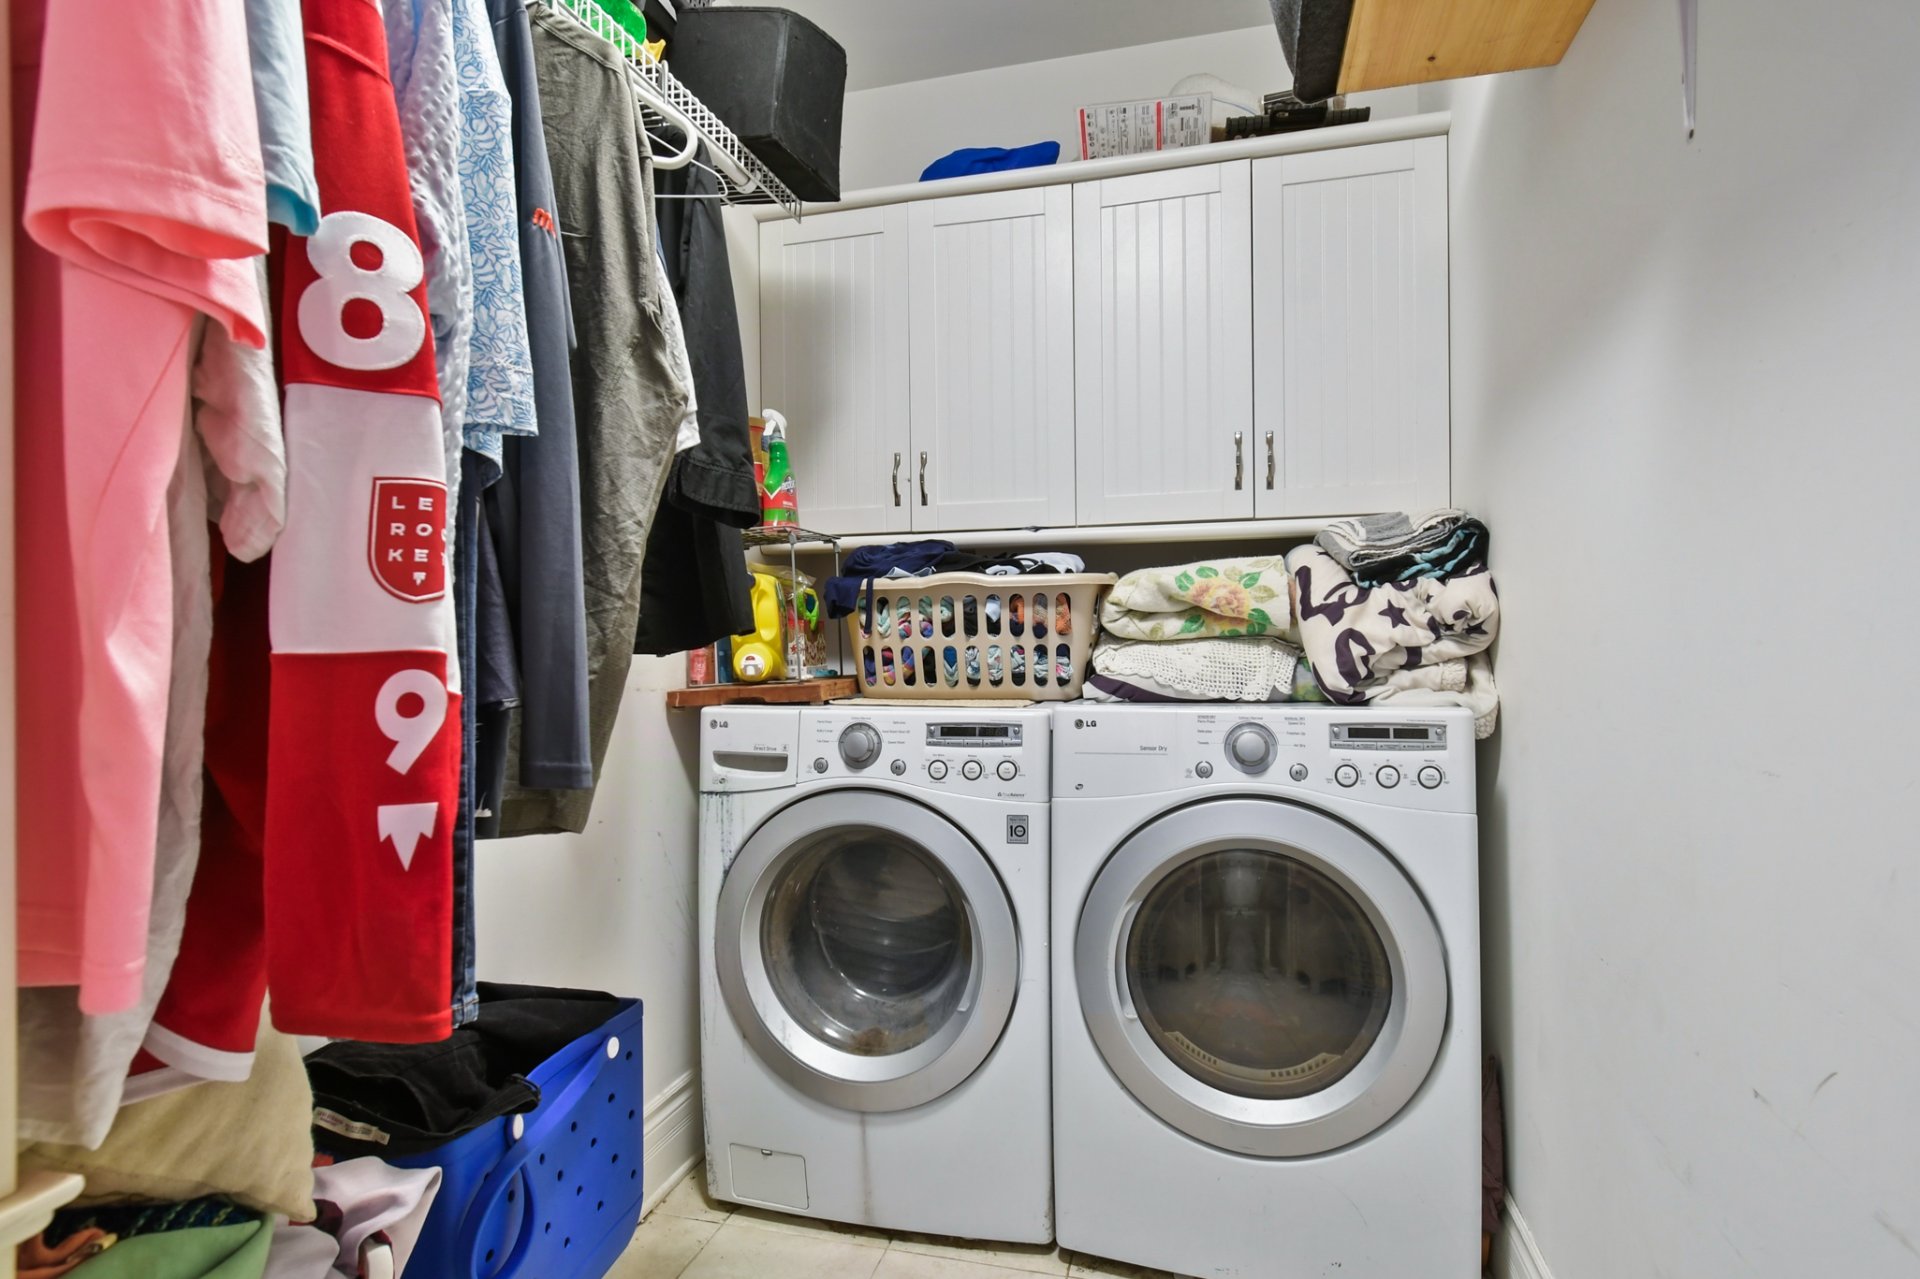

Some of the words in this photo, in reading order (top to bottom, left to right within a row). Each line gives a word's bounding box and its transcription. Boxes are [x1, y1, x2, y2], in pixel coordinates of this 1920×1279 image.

[298, 211, 426, 371] 8
[391, 495, 434, 512] LE
[374, 668, 449, 776] 9
